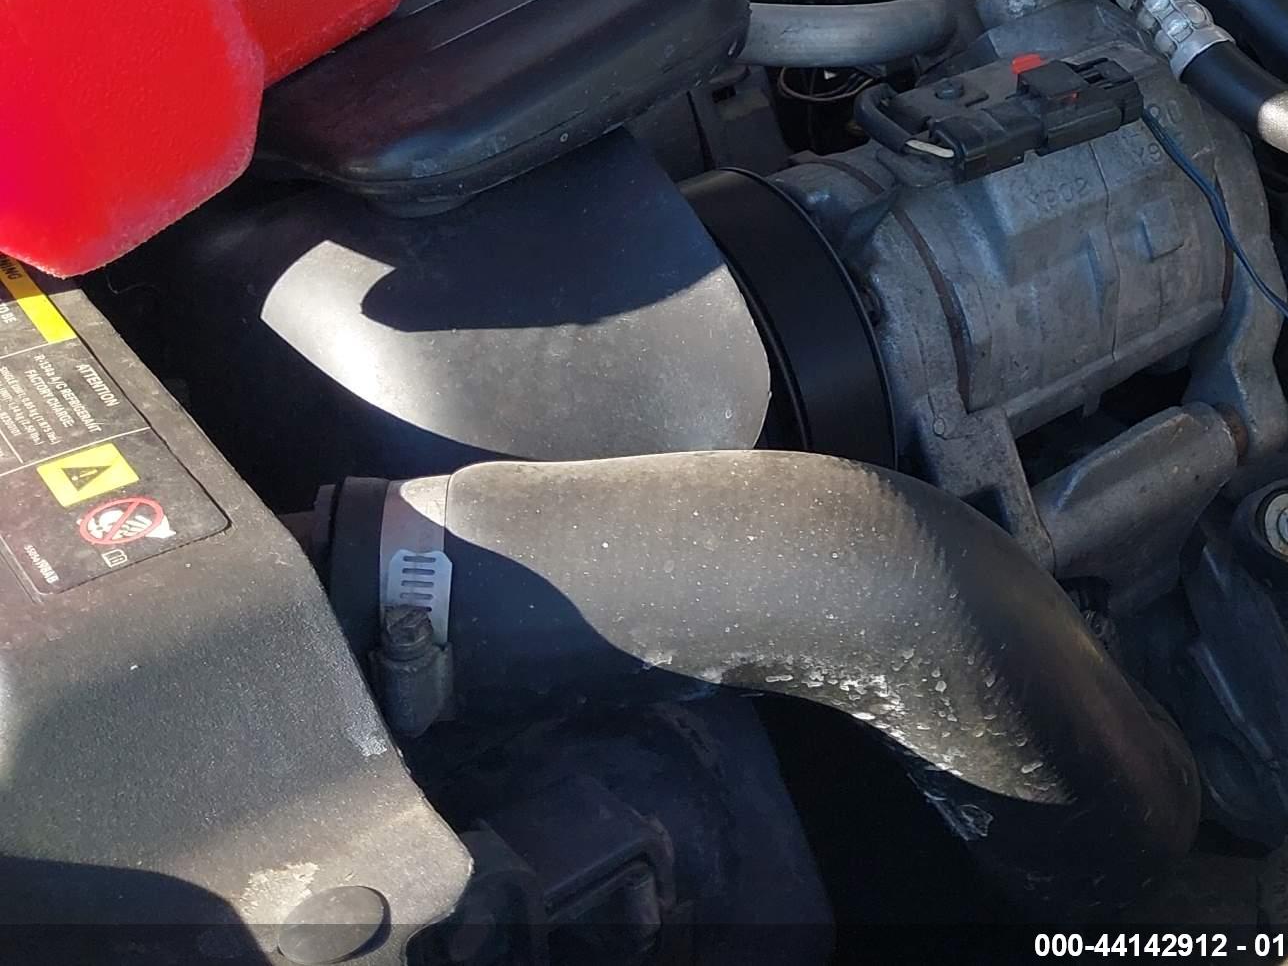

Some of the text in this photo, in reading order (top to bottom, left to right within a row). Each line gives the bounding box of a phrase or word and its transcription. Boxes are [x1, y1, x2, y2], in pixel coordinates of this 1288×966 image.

[24, 369, 55, 398] FACTORY
[34, 354, 102, 433] R-134a A/C REFRIGERANT
[76, 363, 120, 407] ATTENTION
